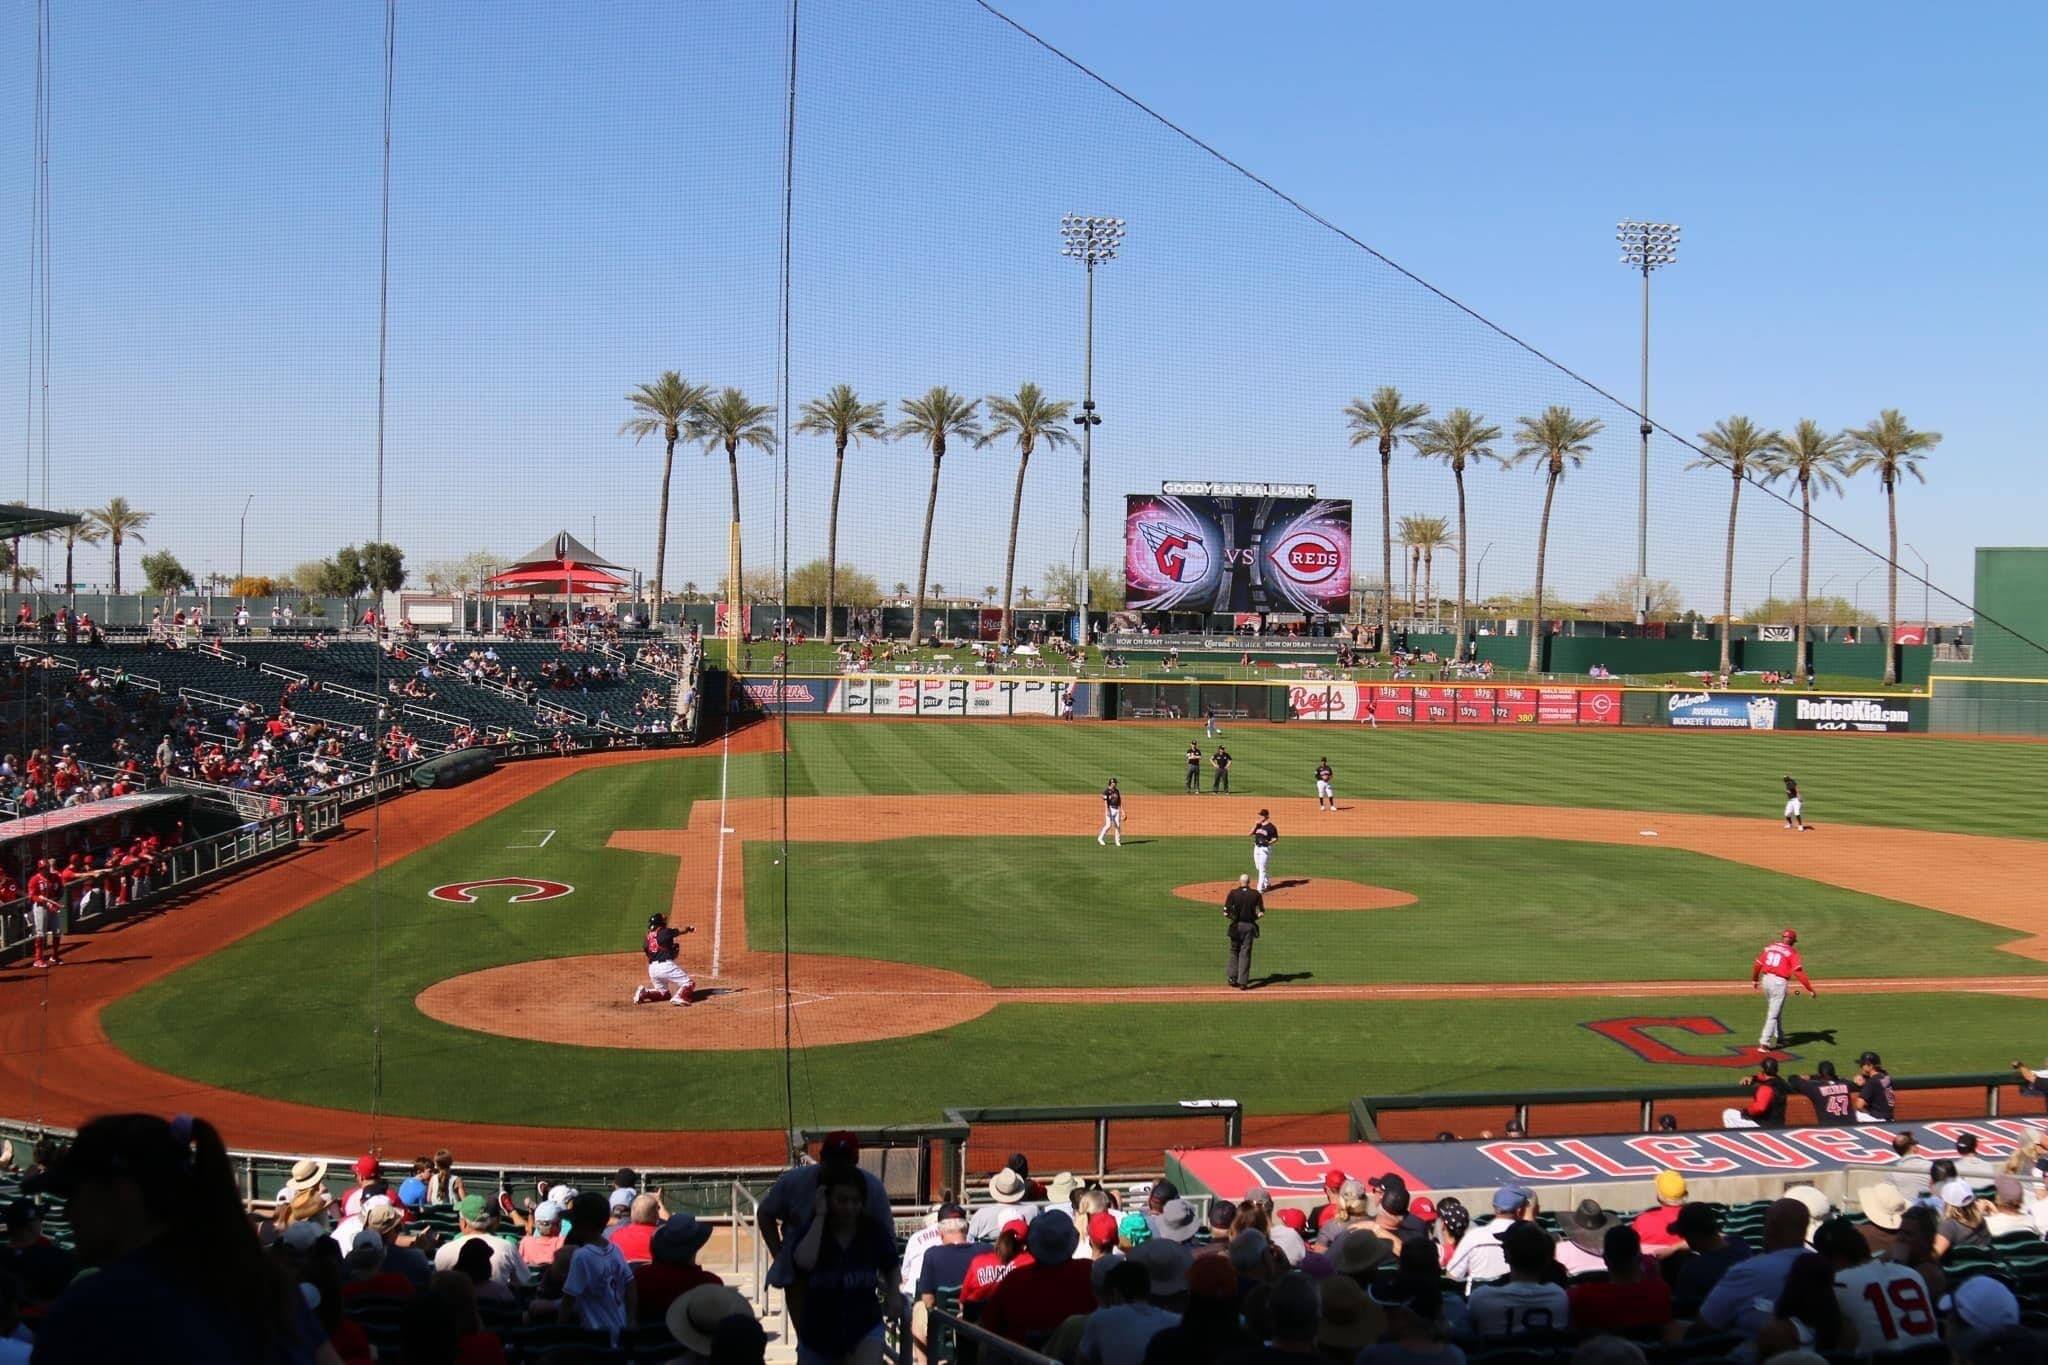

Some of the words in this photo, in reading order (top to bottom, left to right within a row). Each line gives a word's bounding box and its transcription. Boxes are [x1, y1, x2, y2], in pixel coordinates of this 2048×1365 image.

[1163, 483, 1242, 495] GOODYEAR
[1246, 484, 1314, 496] BALLPARK
[1291, 552, 1338, 565] REDS
[1290, 687, 1345, 714] Reds
[1797, 699, 1909, 722] RodeoKia.com
[1711, 718, 1748, 726] GOODYEAR
[1826, 1095, 1849, 1116] 47
[1862, 1278, 1937, 1342] 19
